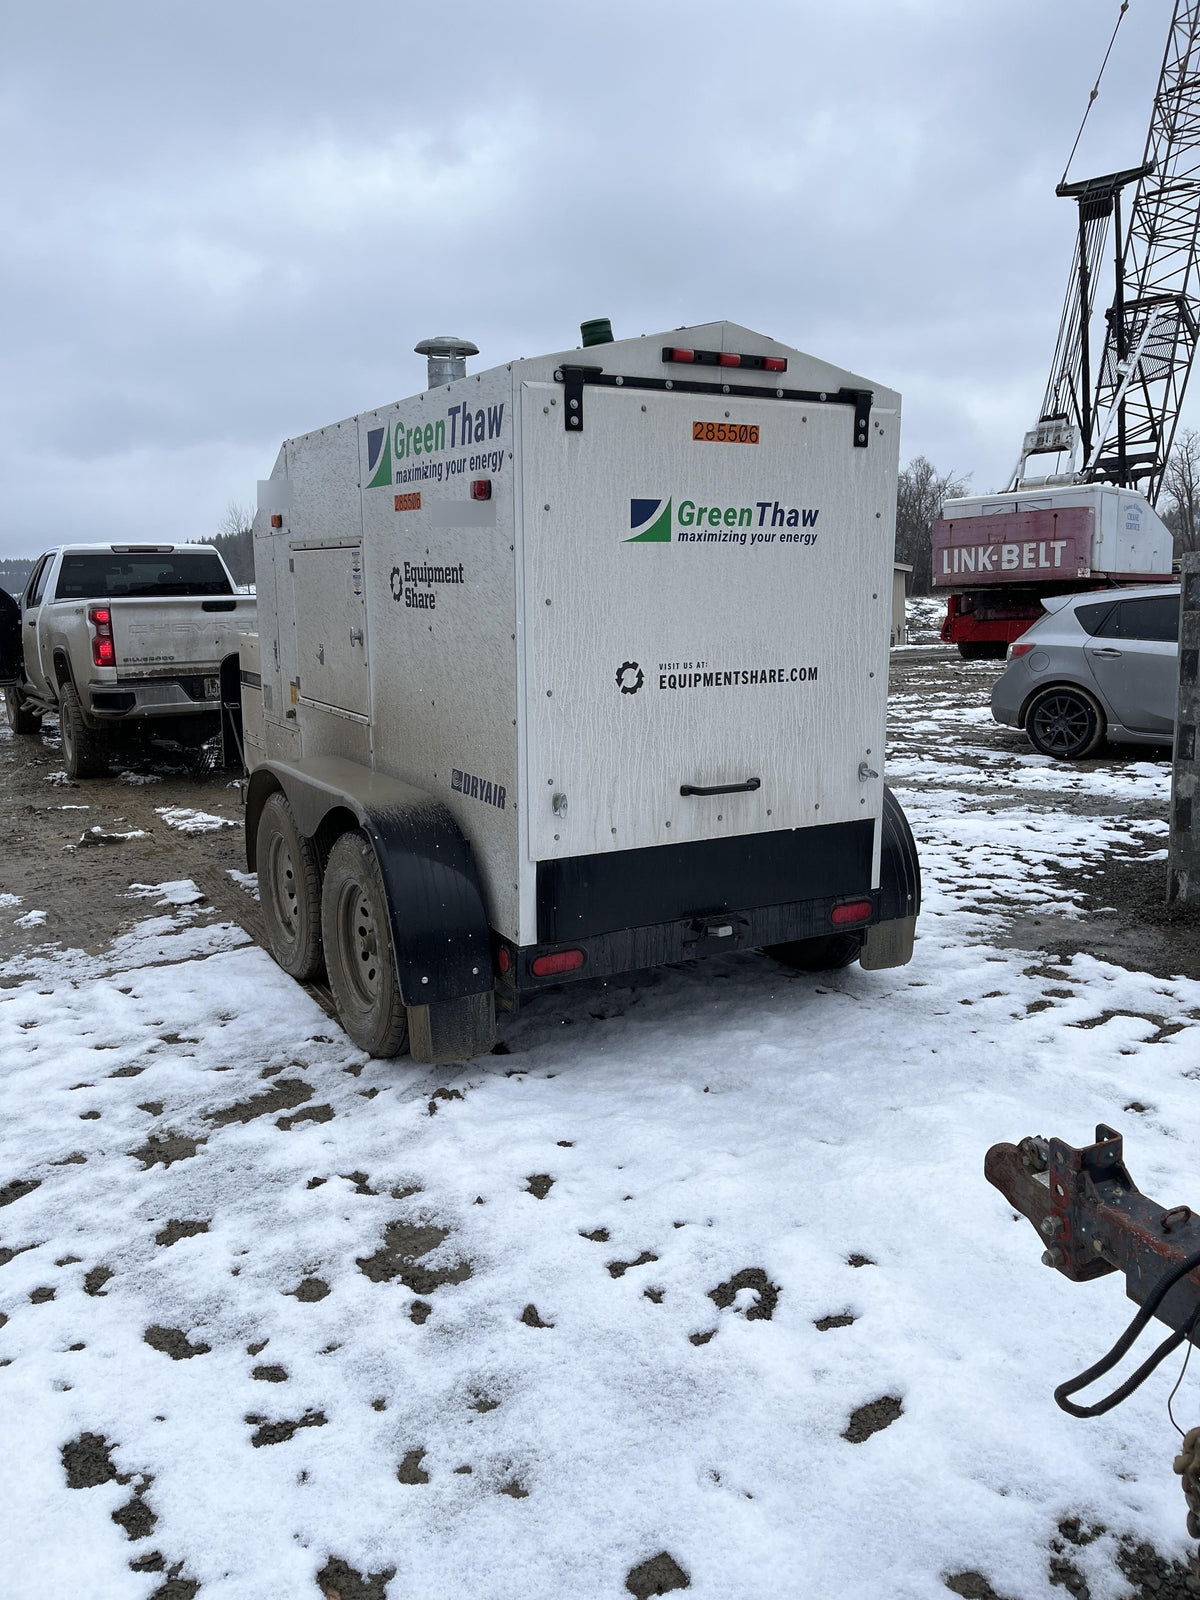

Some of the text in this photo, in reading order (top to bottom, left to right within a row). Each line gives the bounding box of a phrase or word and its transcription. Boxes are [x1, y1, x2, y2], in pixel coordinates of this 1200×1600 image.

[694, 422, 759, 443] 285506
[396, 450, 505, 484] maximizing your energy
[677, 529, 818, 546] maximizing your energy
[943, 541, 1067, 574] LINK-BELT
[403, 561, 464, 588] Equipment
[404, 587, 436, 610] Share
[659, 662, 680, 670] VISIT
[696, 661, 708, 669] AT:
[659, 667, 818, 690] EQUIPMENTSHARE.COM
[463, 772, 507, 810] DRYAIR
